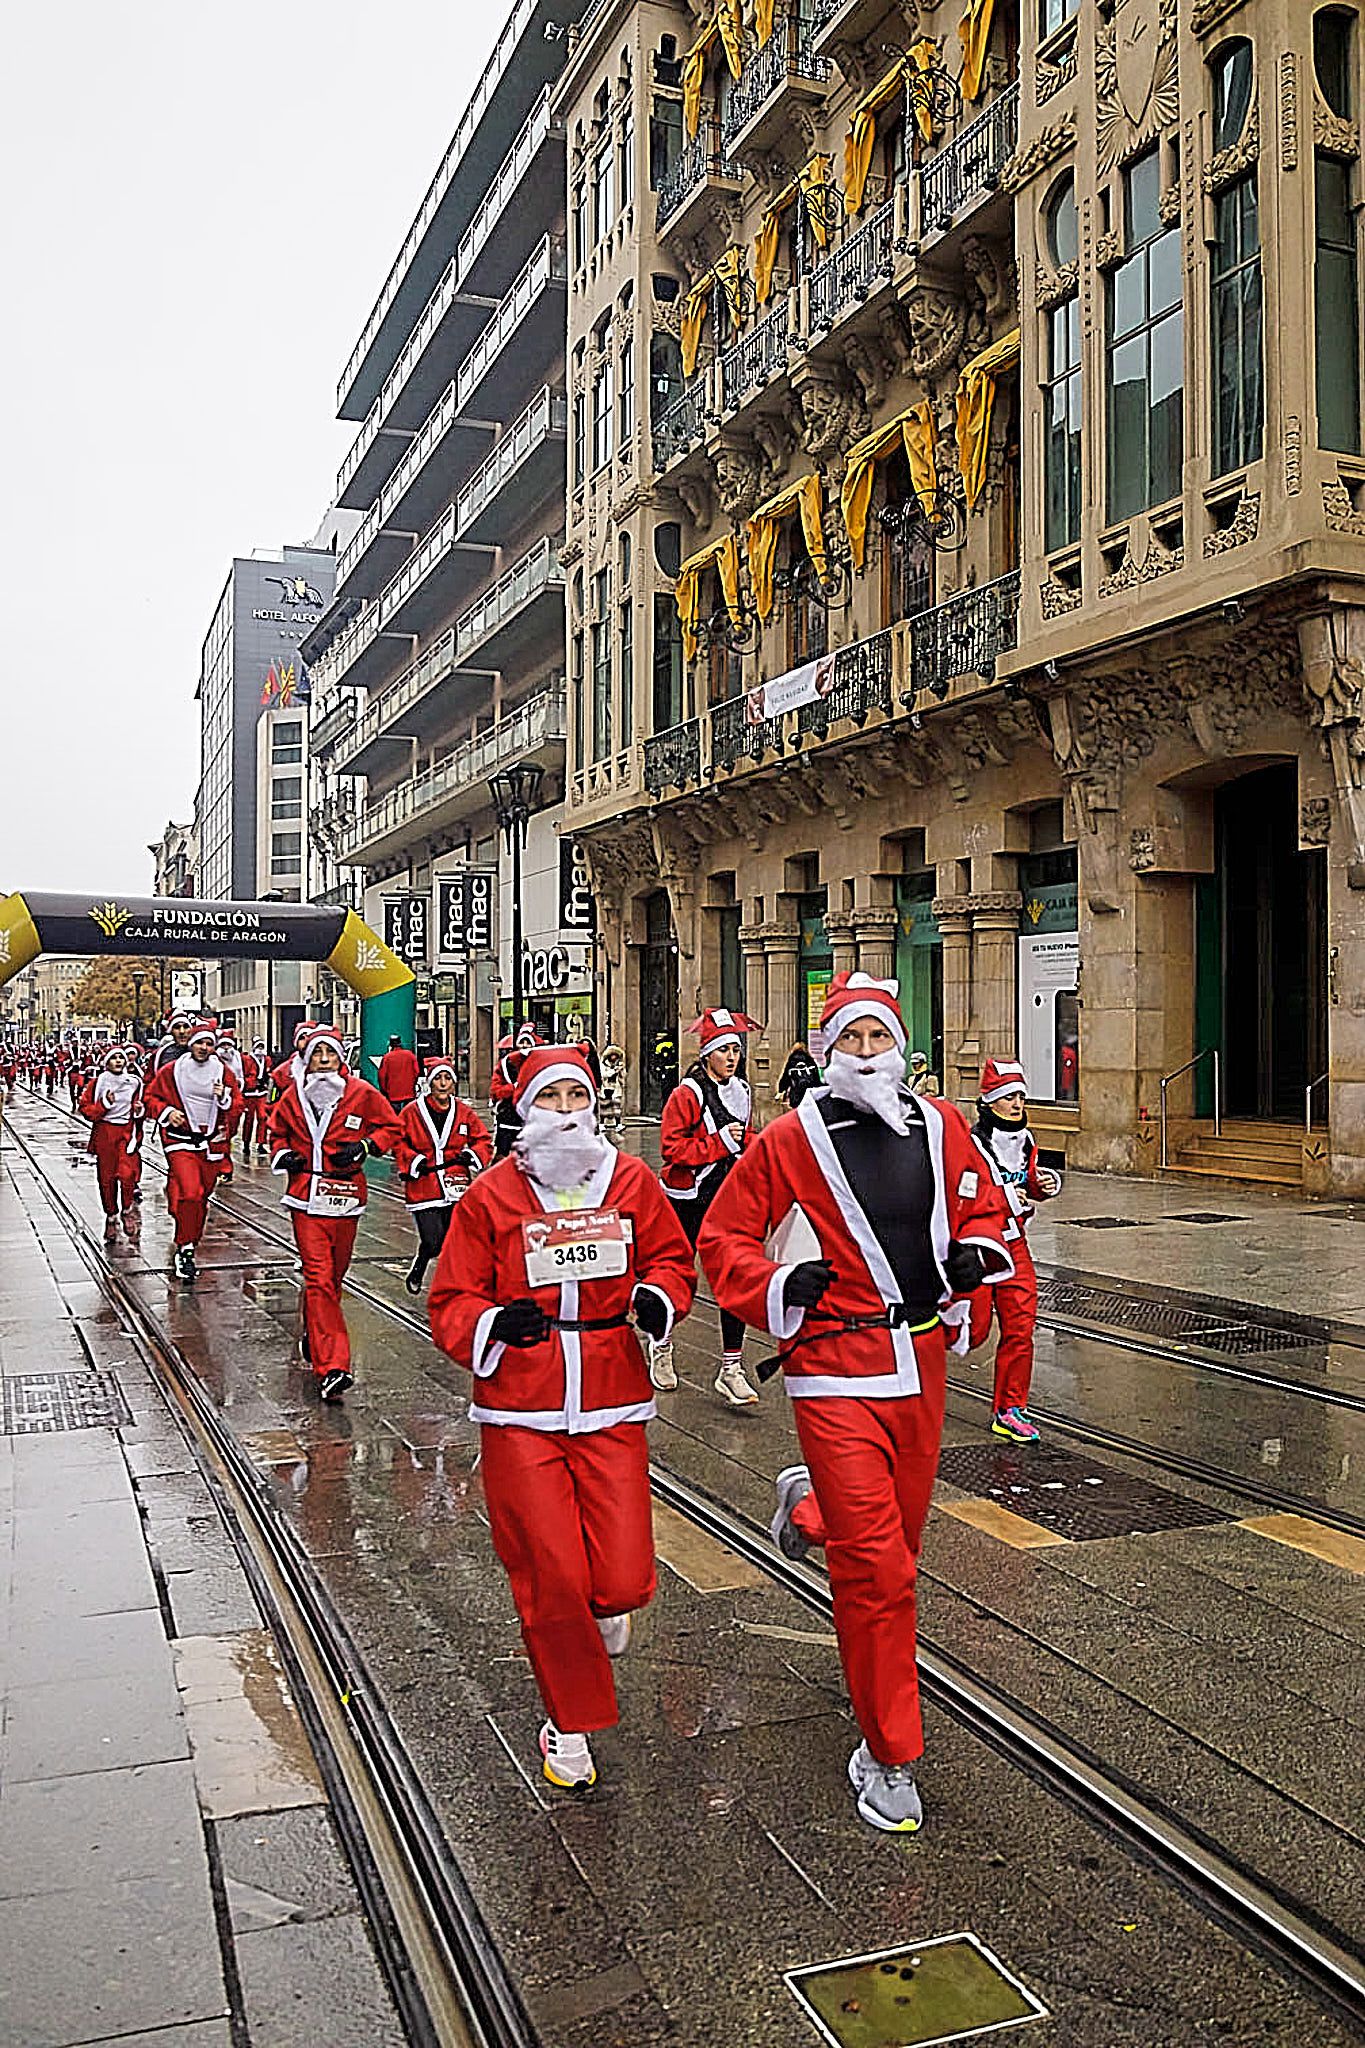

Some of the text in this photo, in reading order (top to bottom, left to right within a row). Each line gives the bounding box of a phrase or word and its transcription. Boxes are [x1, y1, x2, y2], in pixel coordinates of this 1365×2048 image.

[252, 609, 287, 622] HOTEL
[565, 845, 590, 926] fnac
[152, 909, 260, 928] FUNDACIÓN
[404, 900, 424, 959] fnac
[443, 886, 463, 951] fnac
[466, 878, 488, 946] fnac
[124, 927, 287, 943] CAJA RURAL DE ARAGÓN
[520, 947, 563, 990] nac
[554, 1244, 598, 1266] 3436
